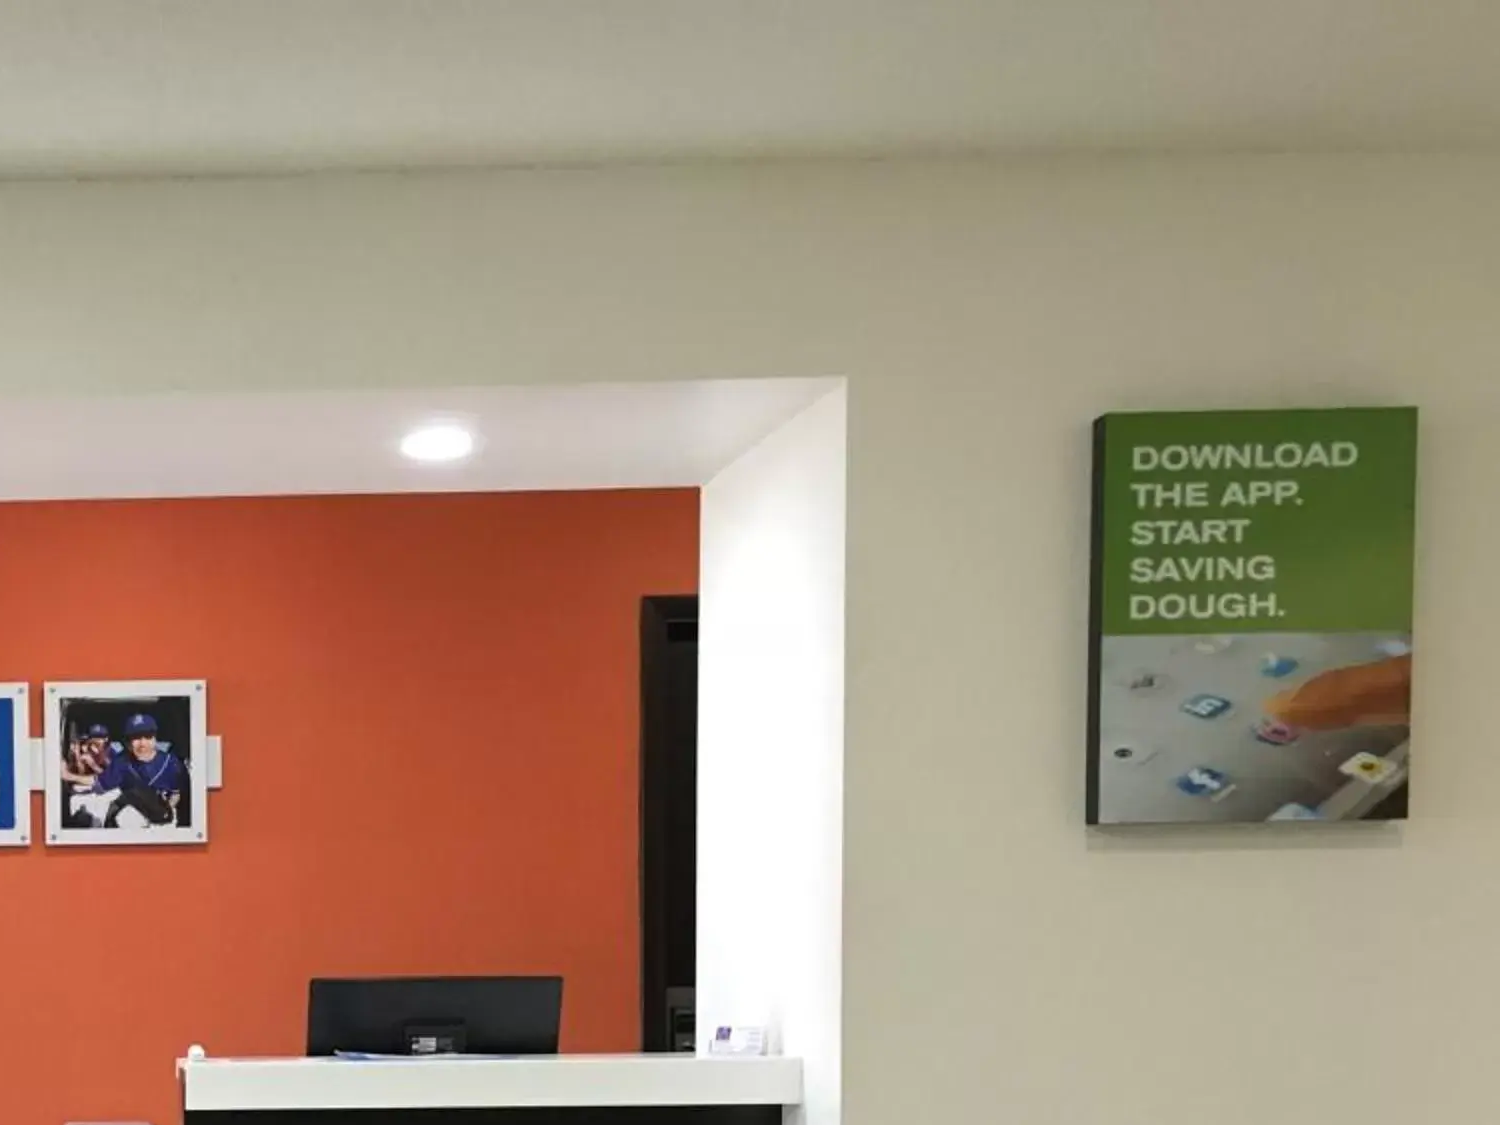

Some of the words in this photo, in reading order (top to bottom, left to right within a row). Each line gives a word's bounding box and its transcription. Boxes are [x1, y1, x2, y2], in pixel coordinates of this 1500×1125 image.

[1132, 441, 1359, 471] DOWNLOAD
[1130, 482, 1209, 508] THE
[1220, 480, 1304, 507] APP.
[1129, 518, 1251, 546] START
[1129, 555, 1276, 583] SAVING
[1129, 592, 1286, 620] DOUGH.
